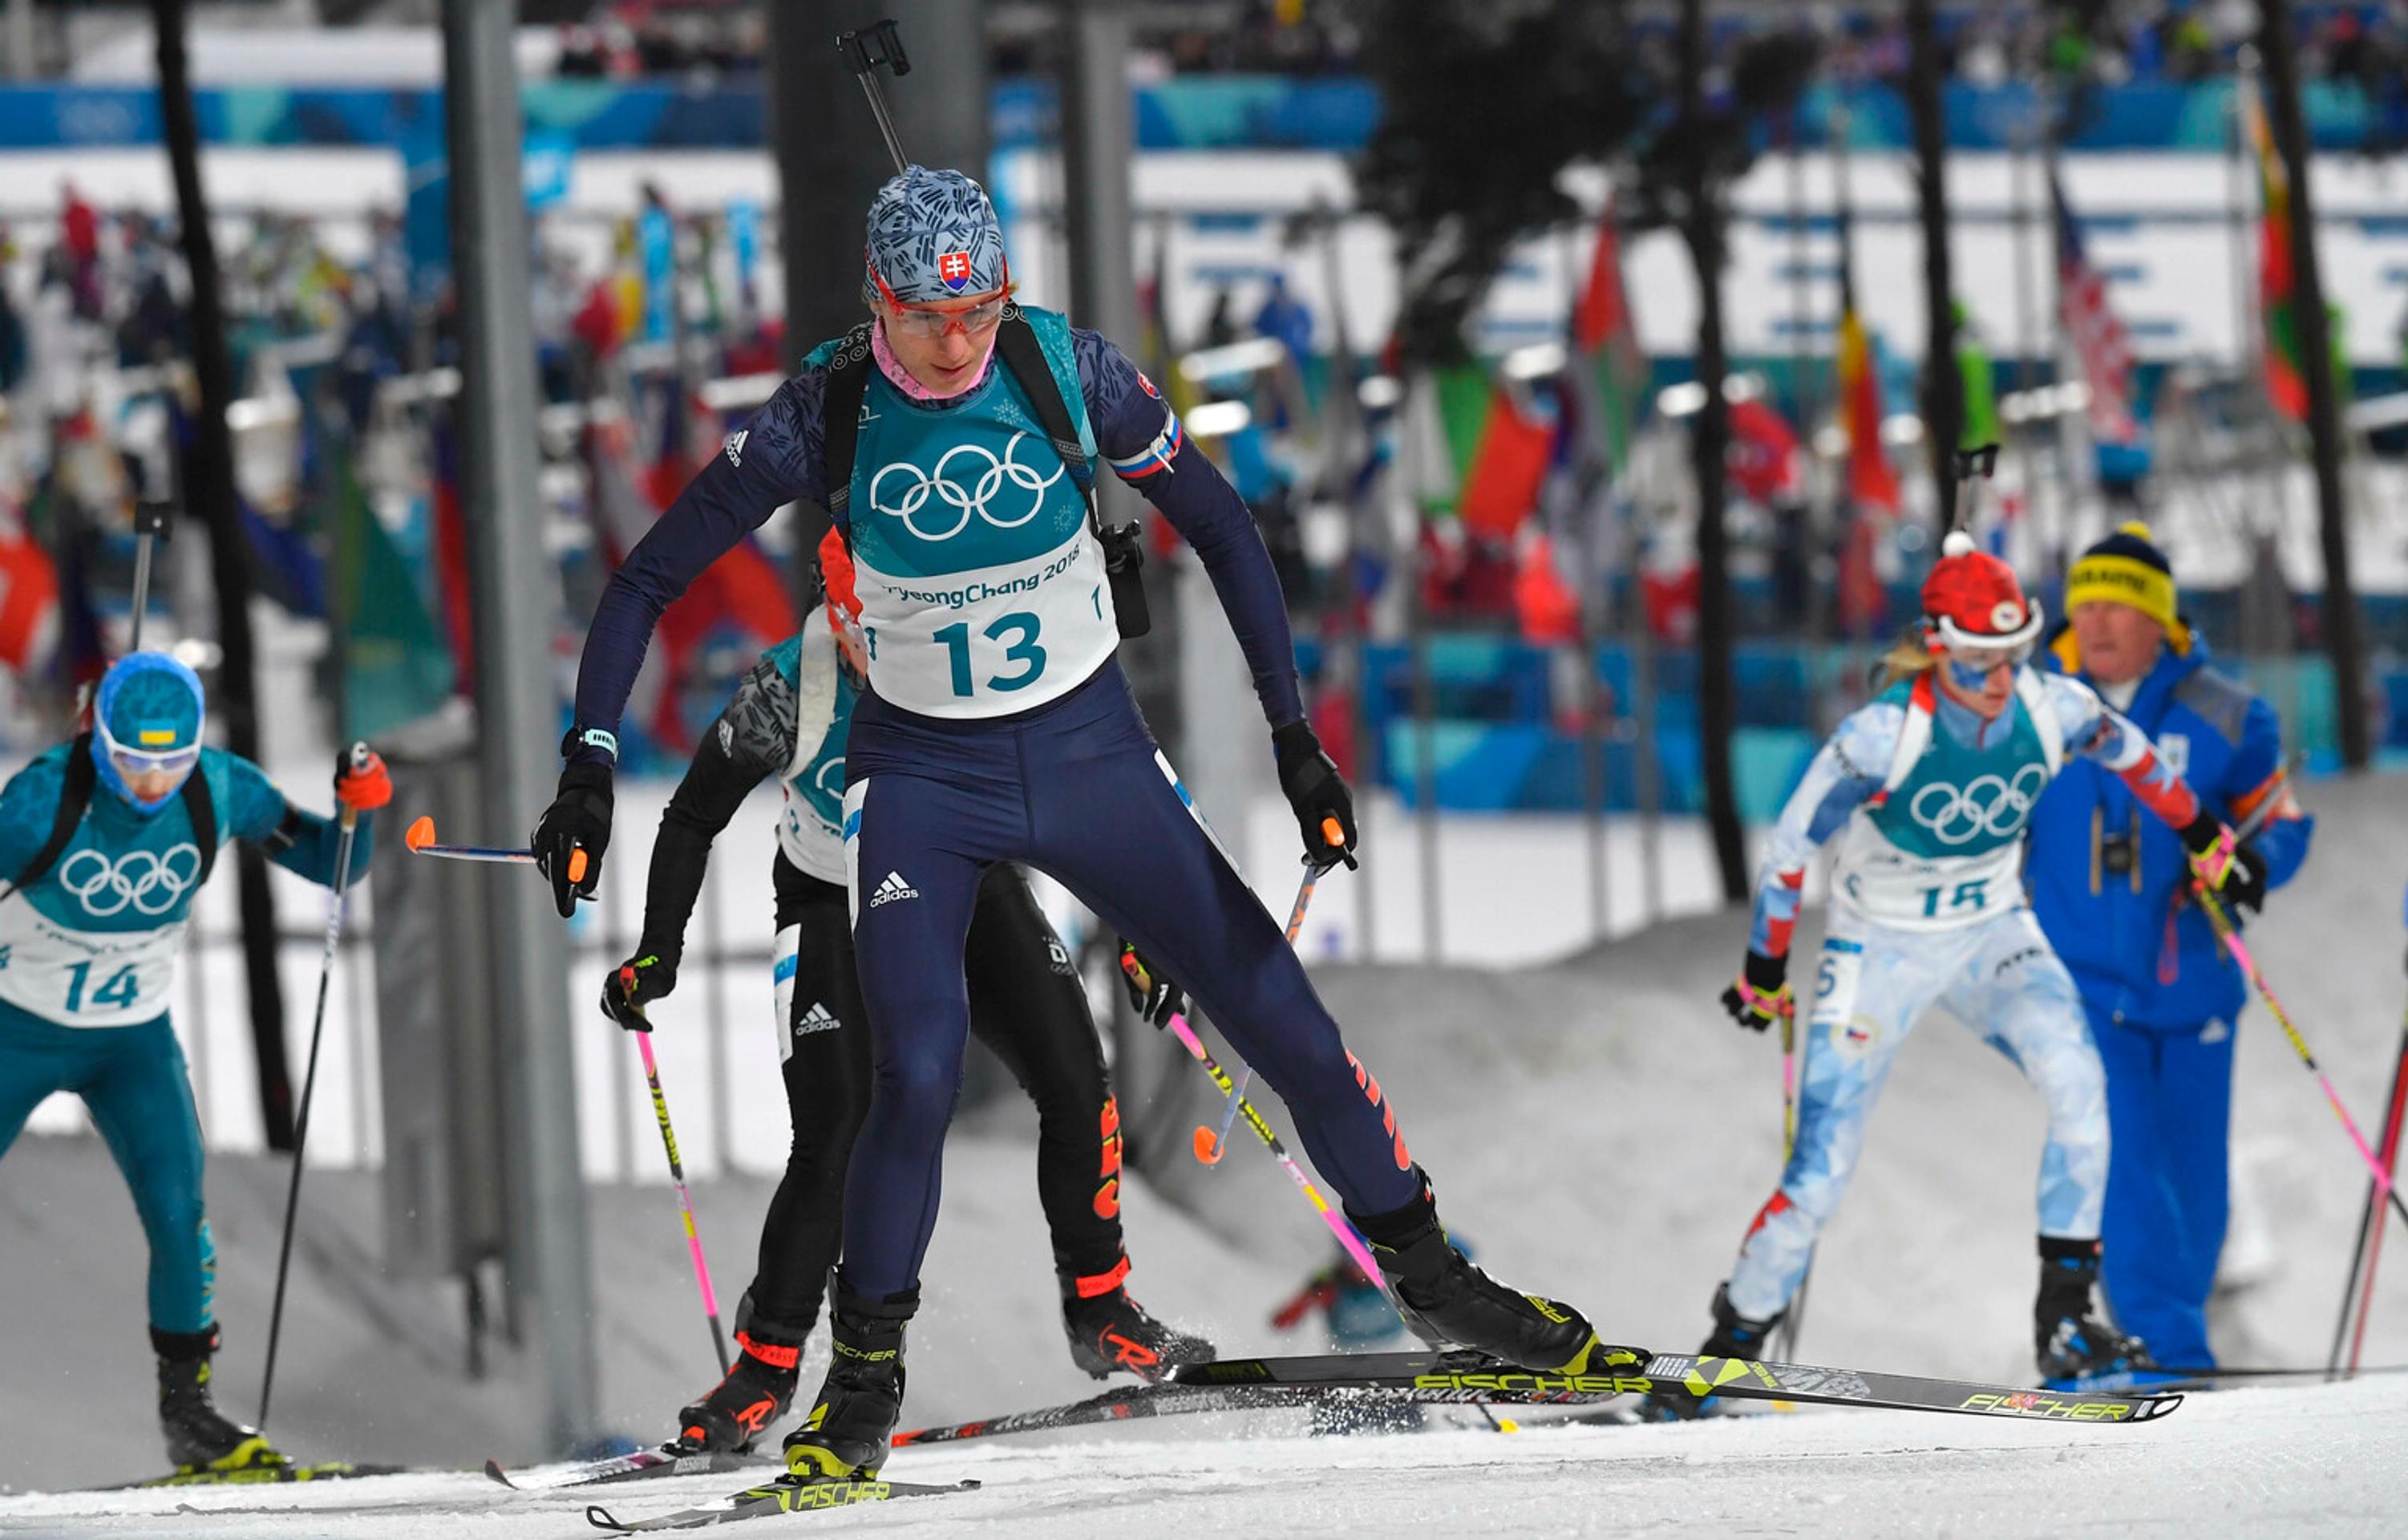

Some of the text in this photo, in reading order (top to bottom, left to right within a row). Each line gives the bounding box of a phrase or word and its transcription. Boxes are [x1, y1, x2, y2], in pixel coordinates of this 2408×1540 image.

[933, 611, 1047, 698] 13
[869, 888, 919, 908] adidas
[64, 960, 140, 1013] 14
[795, 1019, 841, 1036] adidas
[1414, 1374, 1653, 1395] FISCHER
[797, 1481, 891, 1510] FISCHER
